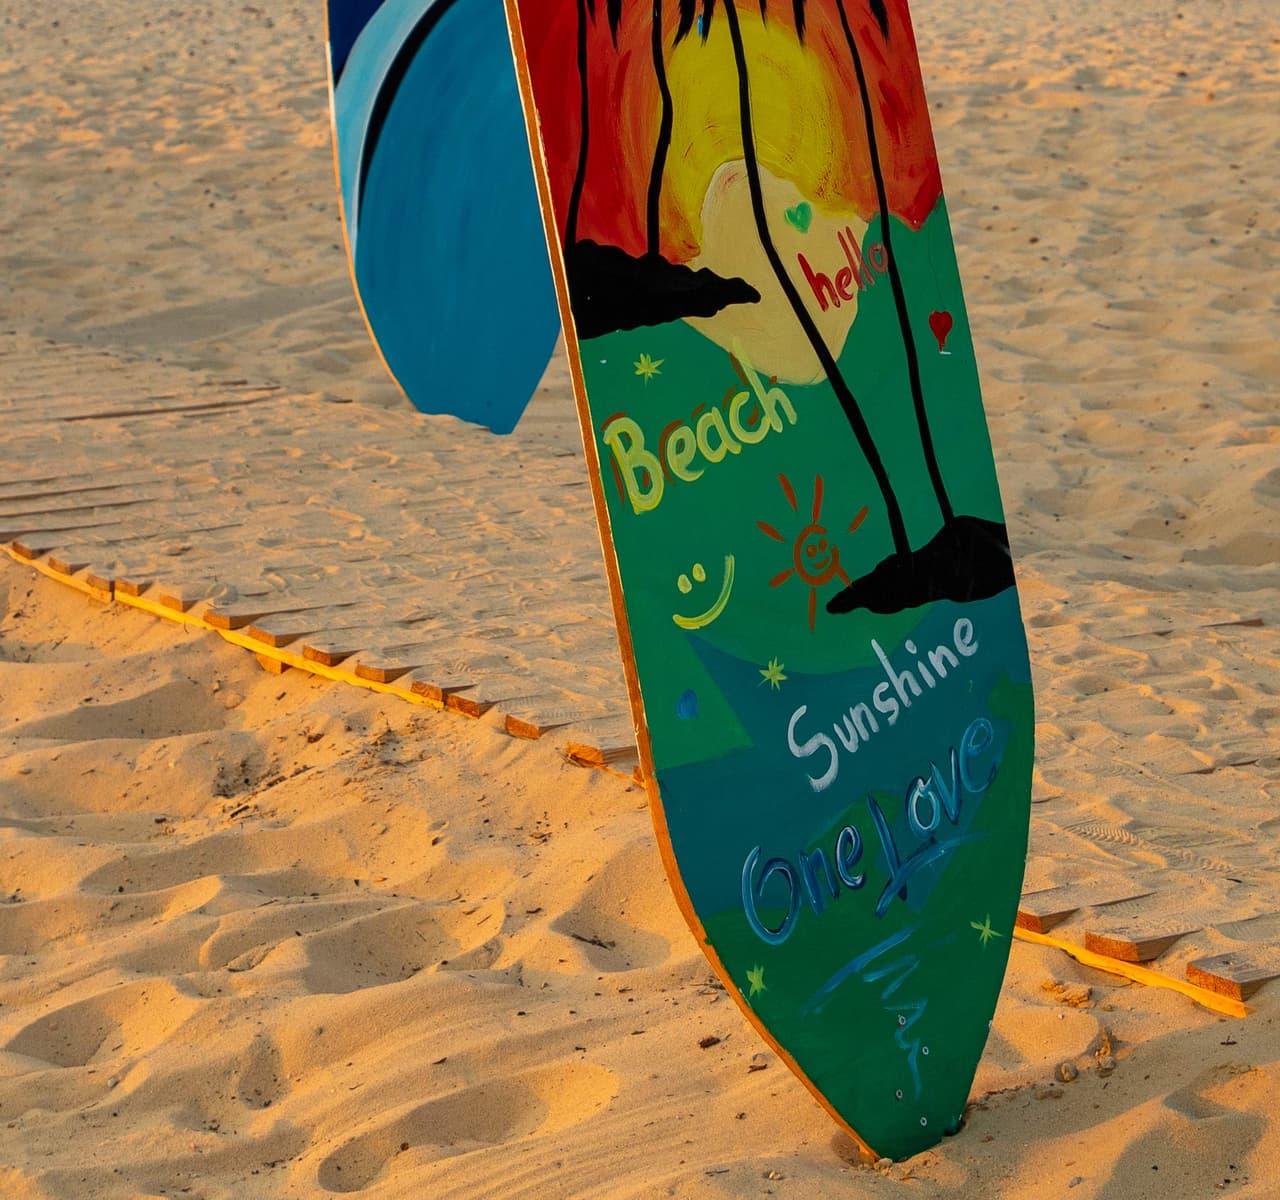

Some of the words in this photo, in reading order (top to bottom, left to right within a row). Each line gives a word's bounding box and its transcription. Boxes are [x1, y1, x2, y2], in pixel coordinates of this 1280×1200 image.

[797, 226, 889, 312] hello
[603, 337, 797, 515] Beach
[787, 617, 978, 792] Sunshine
[742, 824, 867, 946] One
